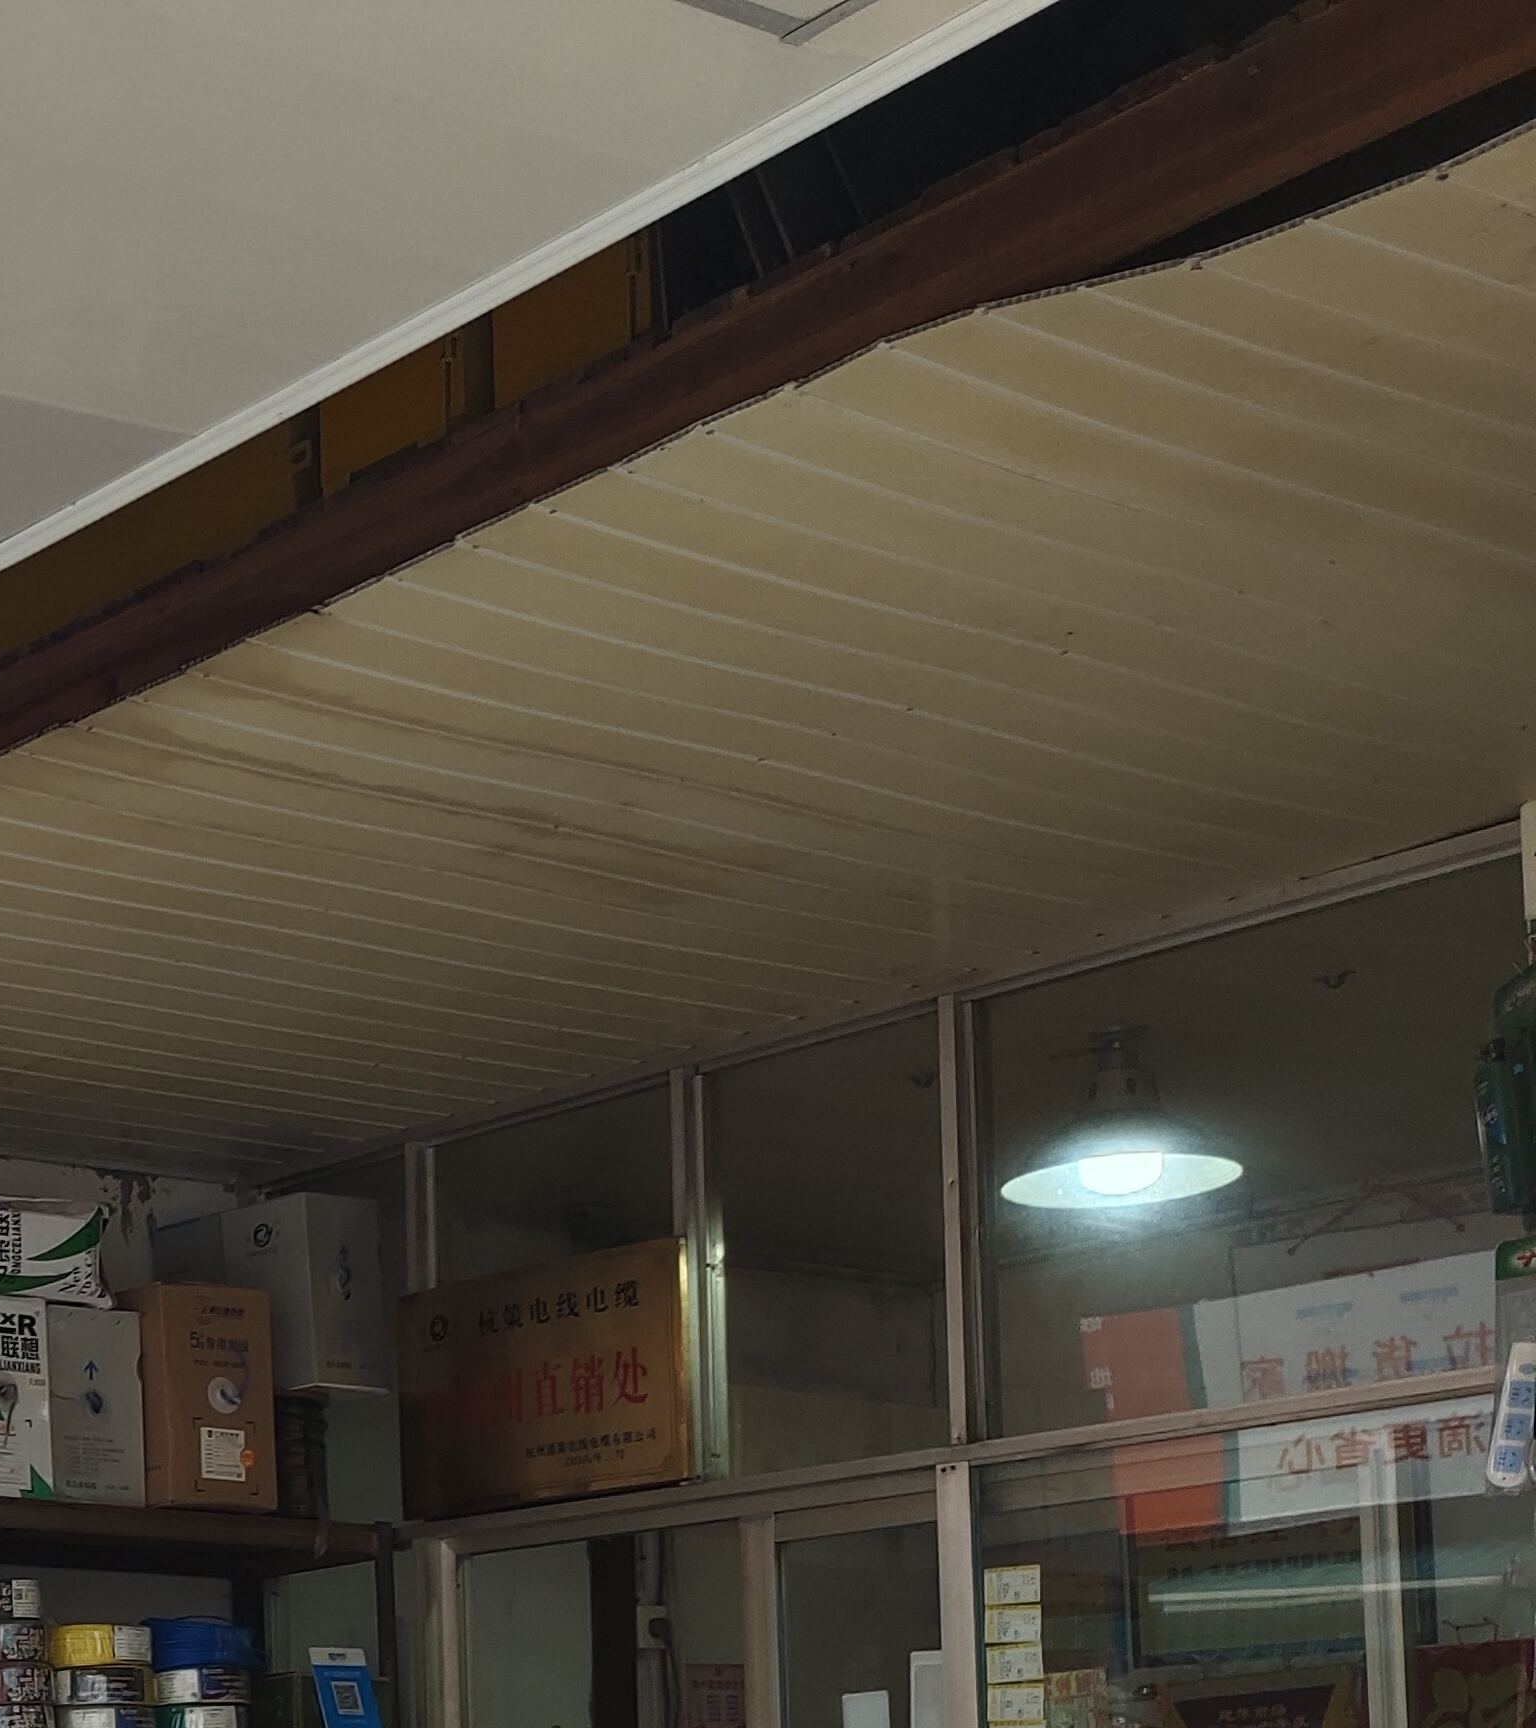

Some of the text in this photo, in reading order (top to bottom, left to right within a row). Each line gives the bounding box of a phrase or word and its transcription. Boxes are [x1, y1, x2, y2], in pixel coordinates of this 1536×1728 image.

[478, 1280, 640, 1337] 杭策电线电缆
